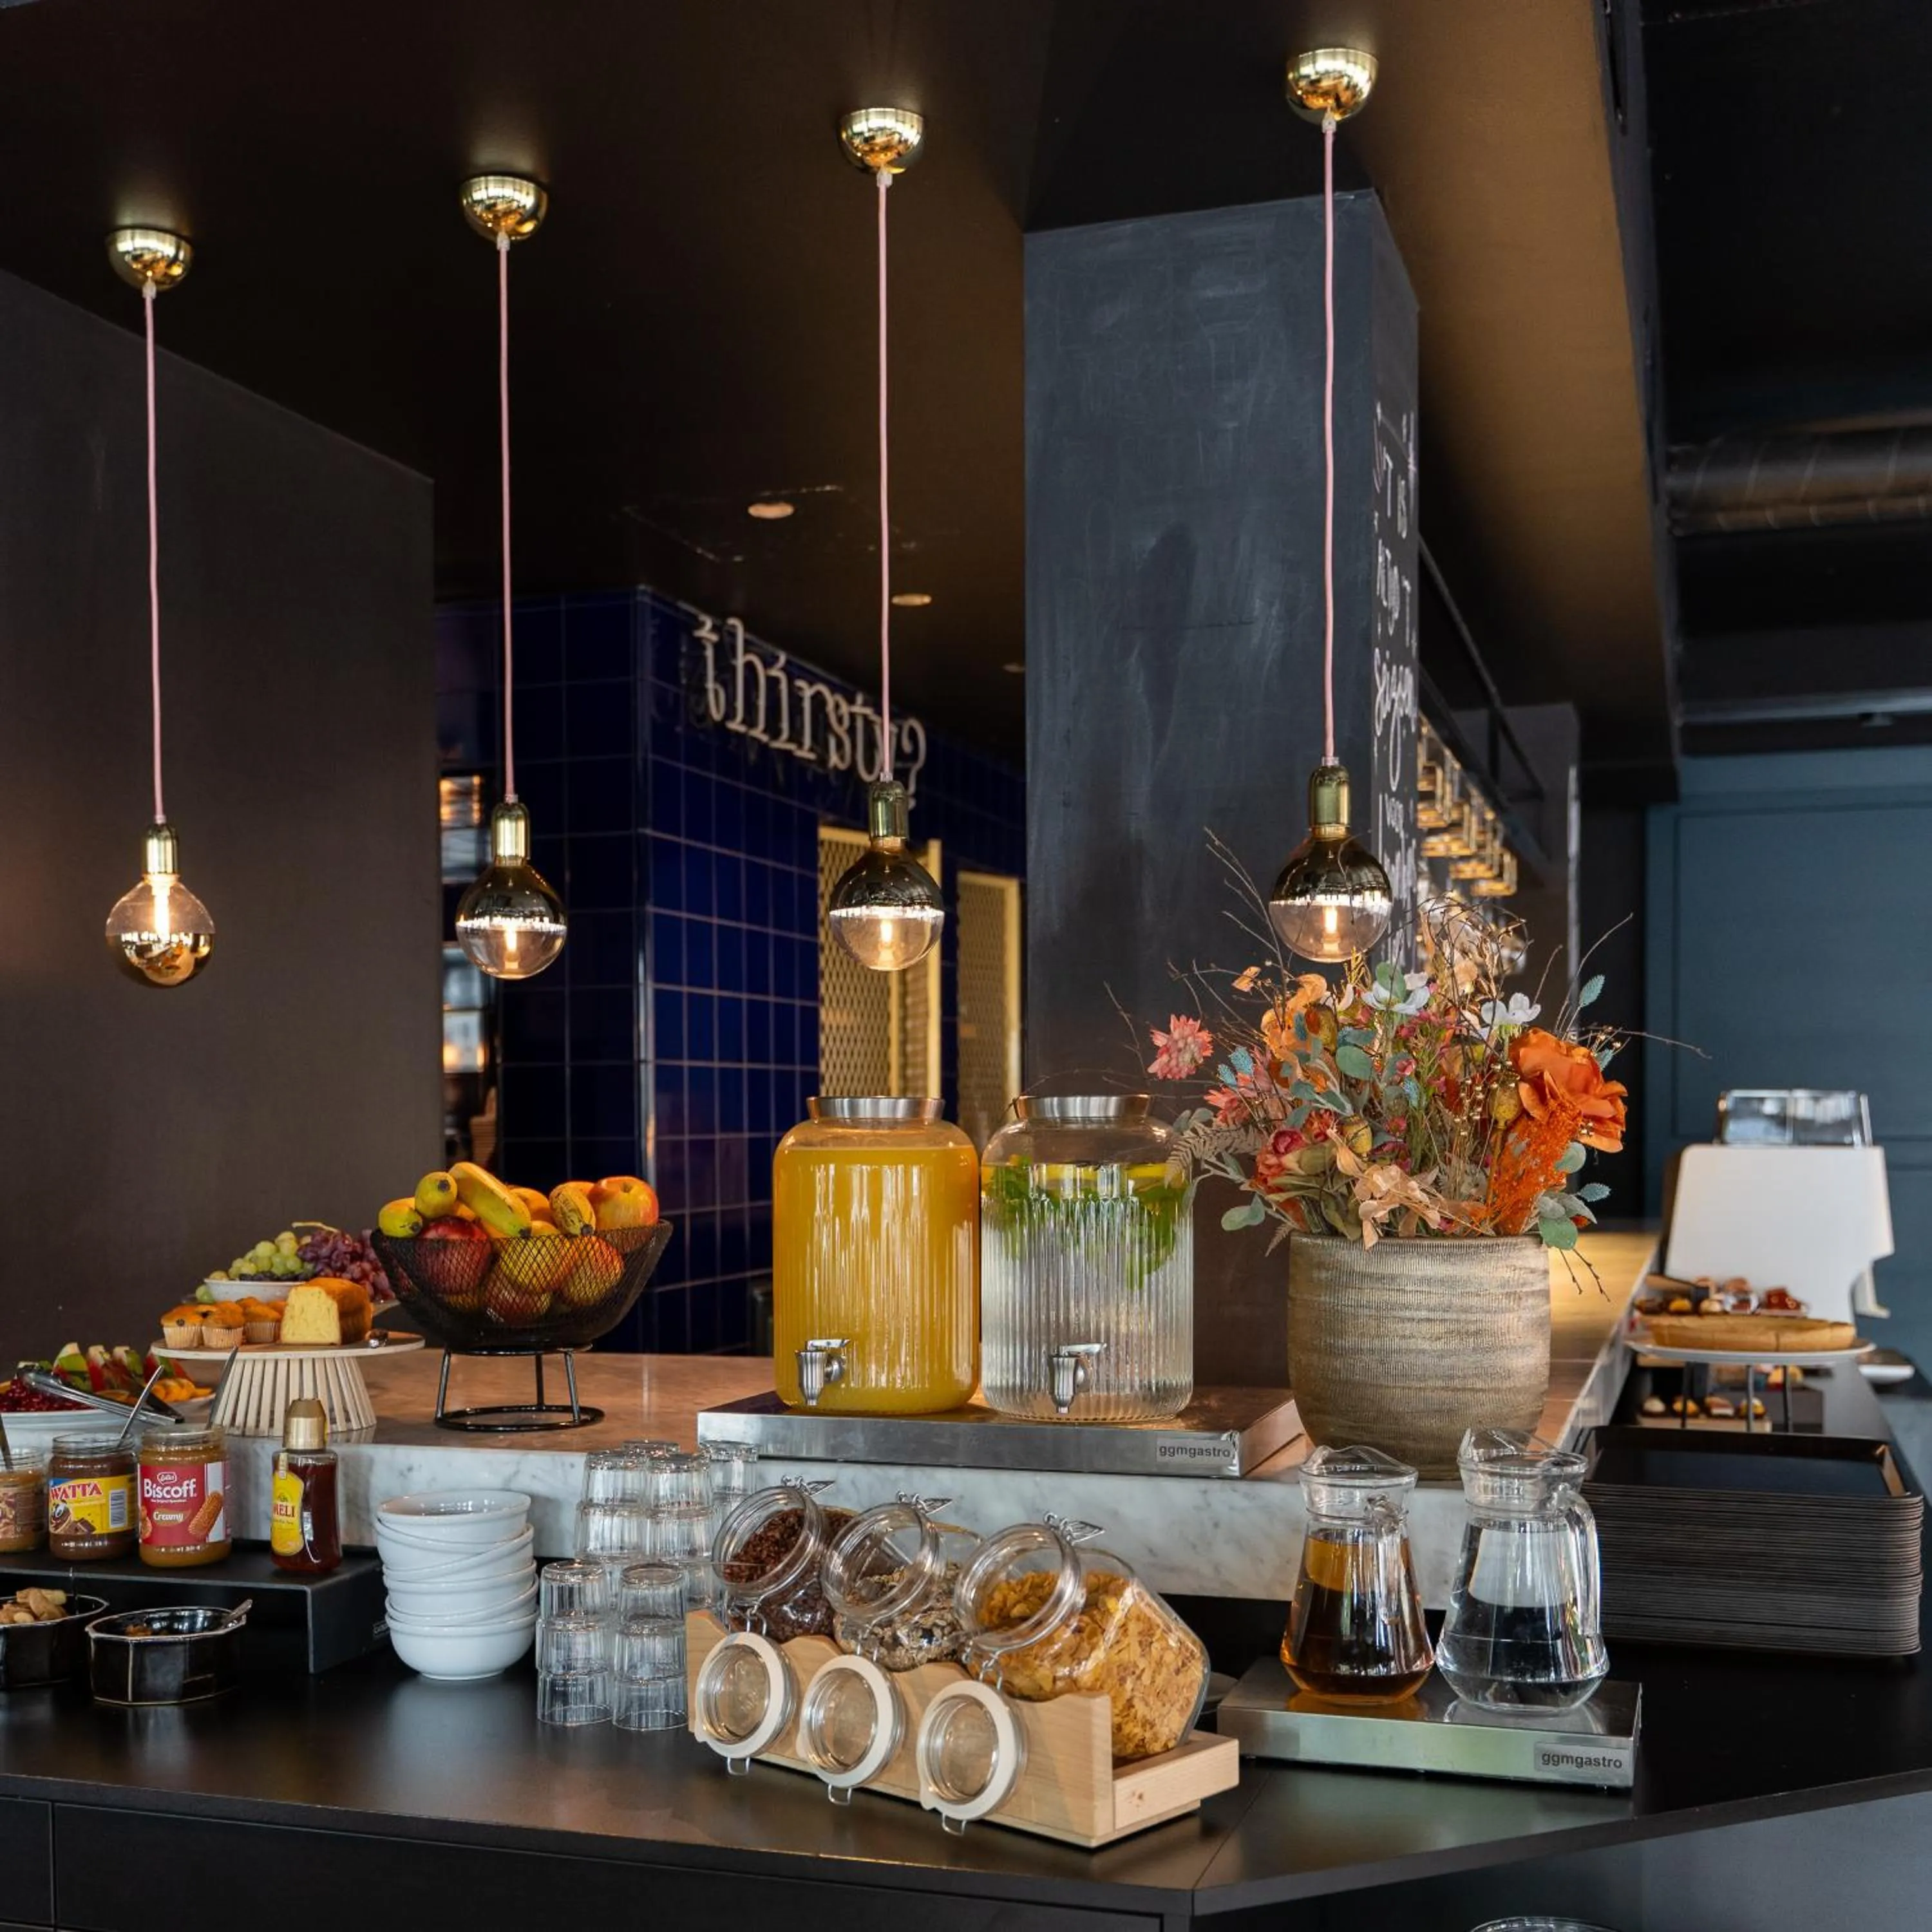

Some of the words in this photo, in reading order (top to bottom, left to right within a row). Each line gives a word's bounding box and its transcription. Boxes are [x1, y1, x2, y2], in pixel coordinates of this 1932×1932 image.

[1159, 1446, 1231, 1458] ggmgastro
[144, 1478, 196, 1499] Biscoff
[153, 1511, 184, 1523] Creamy
[1542, 1752, 1622, 1769] ggmgastro
